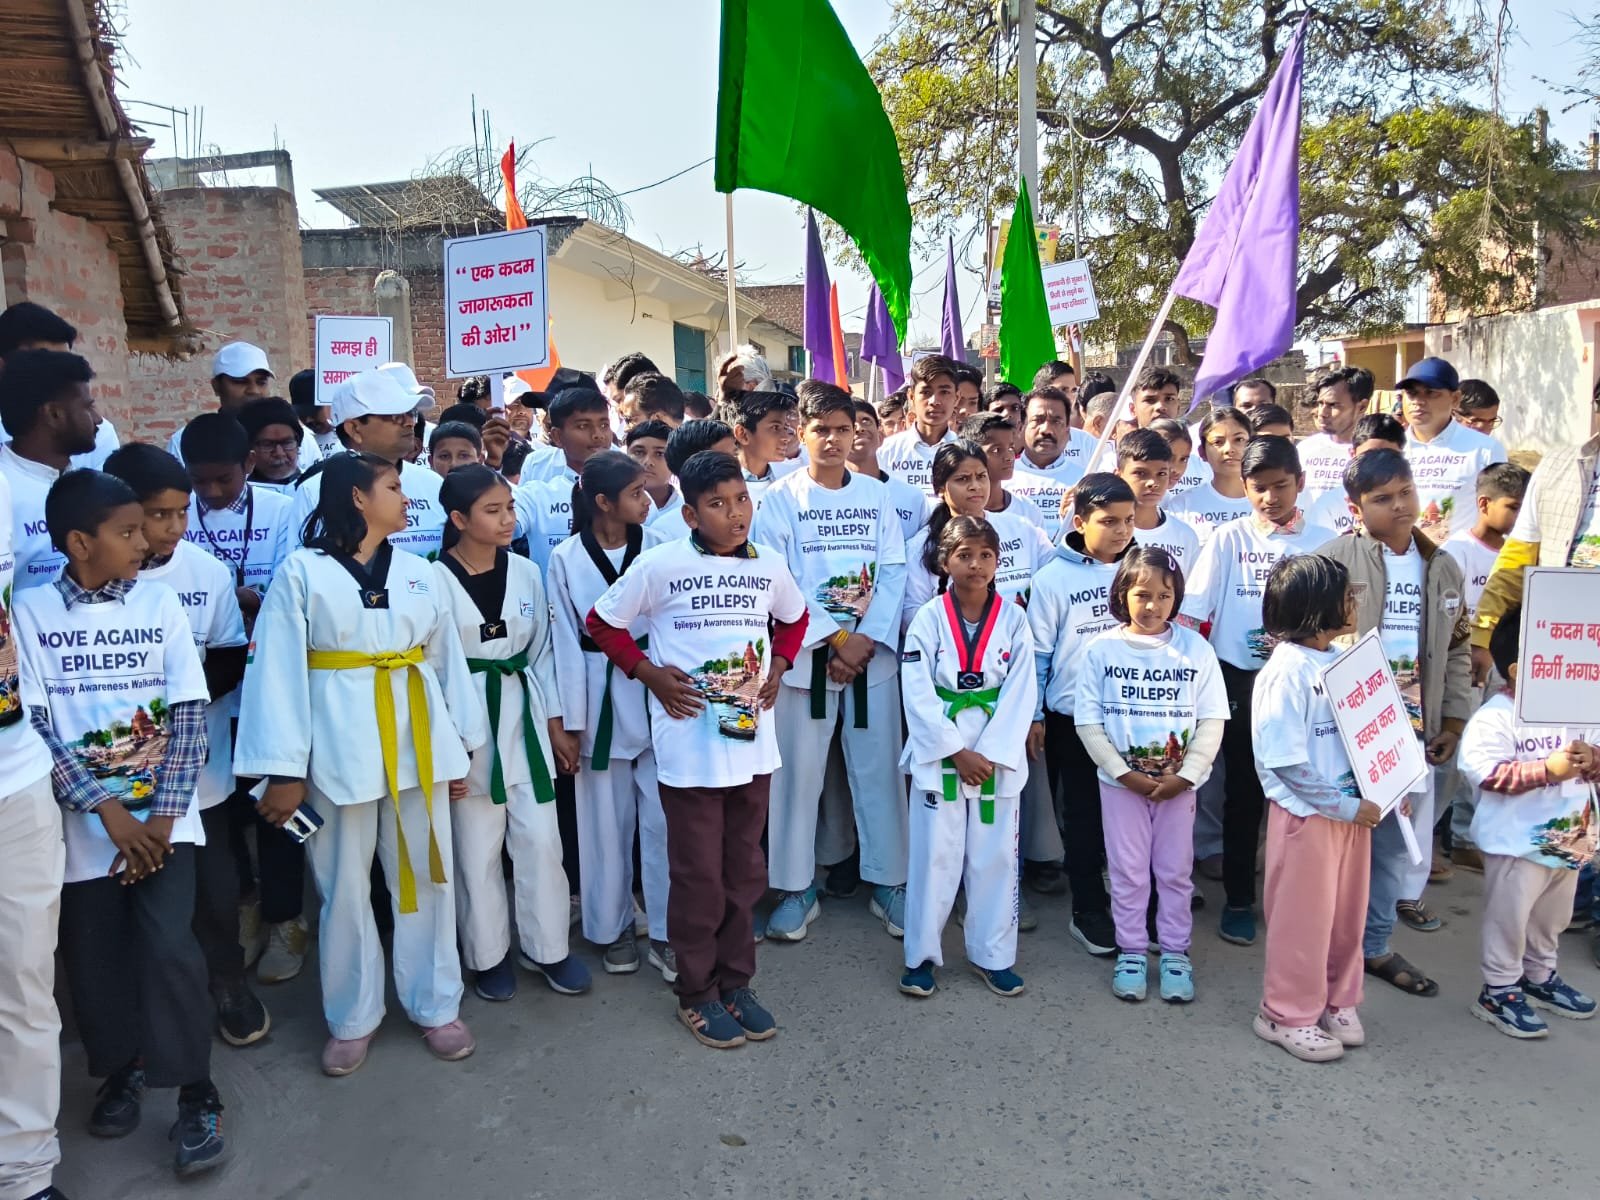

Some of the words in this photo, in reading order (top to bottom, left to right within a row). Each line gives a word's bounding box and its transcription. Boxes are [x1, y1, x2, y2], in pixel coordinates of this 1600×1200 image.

[471, 264, 496, 282] एक
[498, 258, 535, 277] कदम
[458, 291, 533, 314] जागरूकता
[462, 325, 481, 346] की
[484, 322, 516, 344] ओर।
[331, 341, 362, 357] समझ
[365, 336, 377, 356] ही
[892, 460, 923, 470] MOVE
[1418, 456, 1467, 465] AGAINST
[798, 509, 832, 522] MOVE
[836, 508, 878, 520] AGAINS
[1195, 512, 1228, 524] MOVE
[208, 528, 270, 543] AGAINST
[818, 524, 870, 536] EPILEPSY
[802, 545, 826, 554] Epilepsy
[1239, 552, 1275, 564] MOVE
[670, 575, 712, 594] MOVE
[717, 575, 772, 591] AGAINST
[1070, 586, 1107, 606] MOVE
[1236, 588, 1261, 597] Epilepsy
[692, 594, 757, 610] EPILEPSY
[674, 621, 701, 630] Epilepsy
[704, 619, 743, 627] Awareness
[1076, 625, 1101, 635] Epilepsy
[1551, 622, 1584, 640] कदम
[94, 628, 162, 646] AGAINS
[61, 652, 148, 672] EPILEPSY
[1531, 654, 1564, 680] मिर्गी
[1143, 668, 1198, 682] AGAINST
[78, 681, 129, 692] Awareness
[131, 679, 167, 689] Walkatho
[1121, 686, 1181, 701] EPILEPSY
[1346, 680, 1364, 710] चलो
[1129, 708, 1167, 718] Awareness
[1355, 719, 1380, 750] स्वस्थ
[1378, 704, 1396, 728] कल
[1516, 736, 1553, 753] MOVE
[1368, 760, 1380, 784] के
